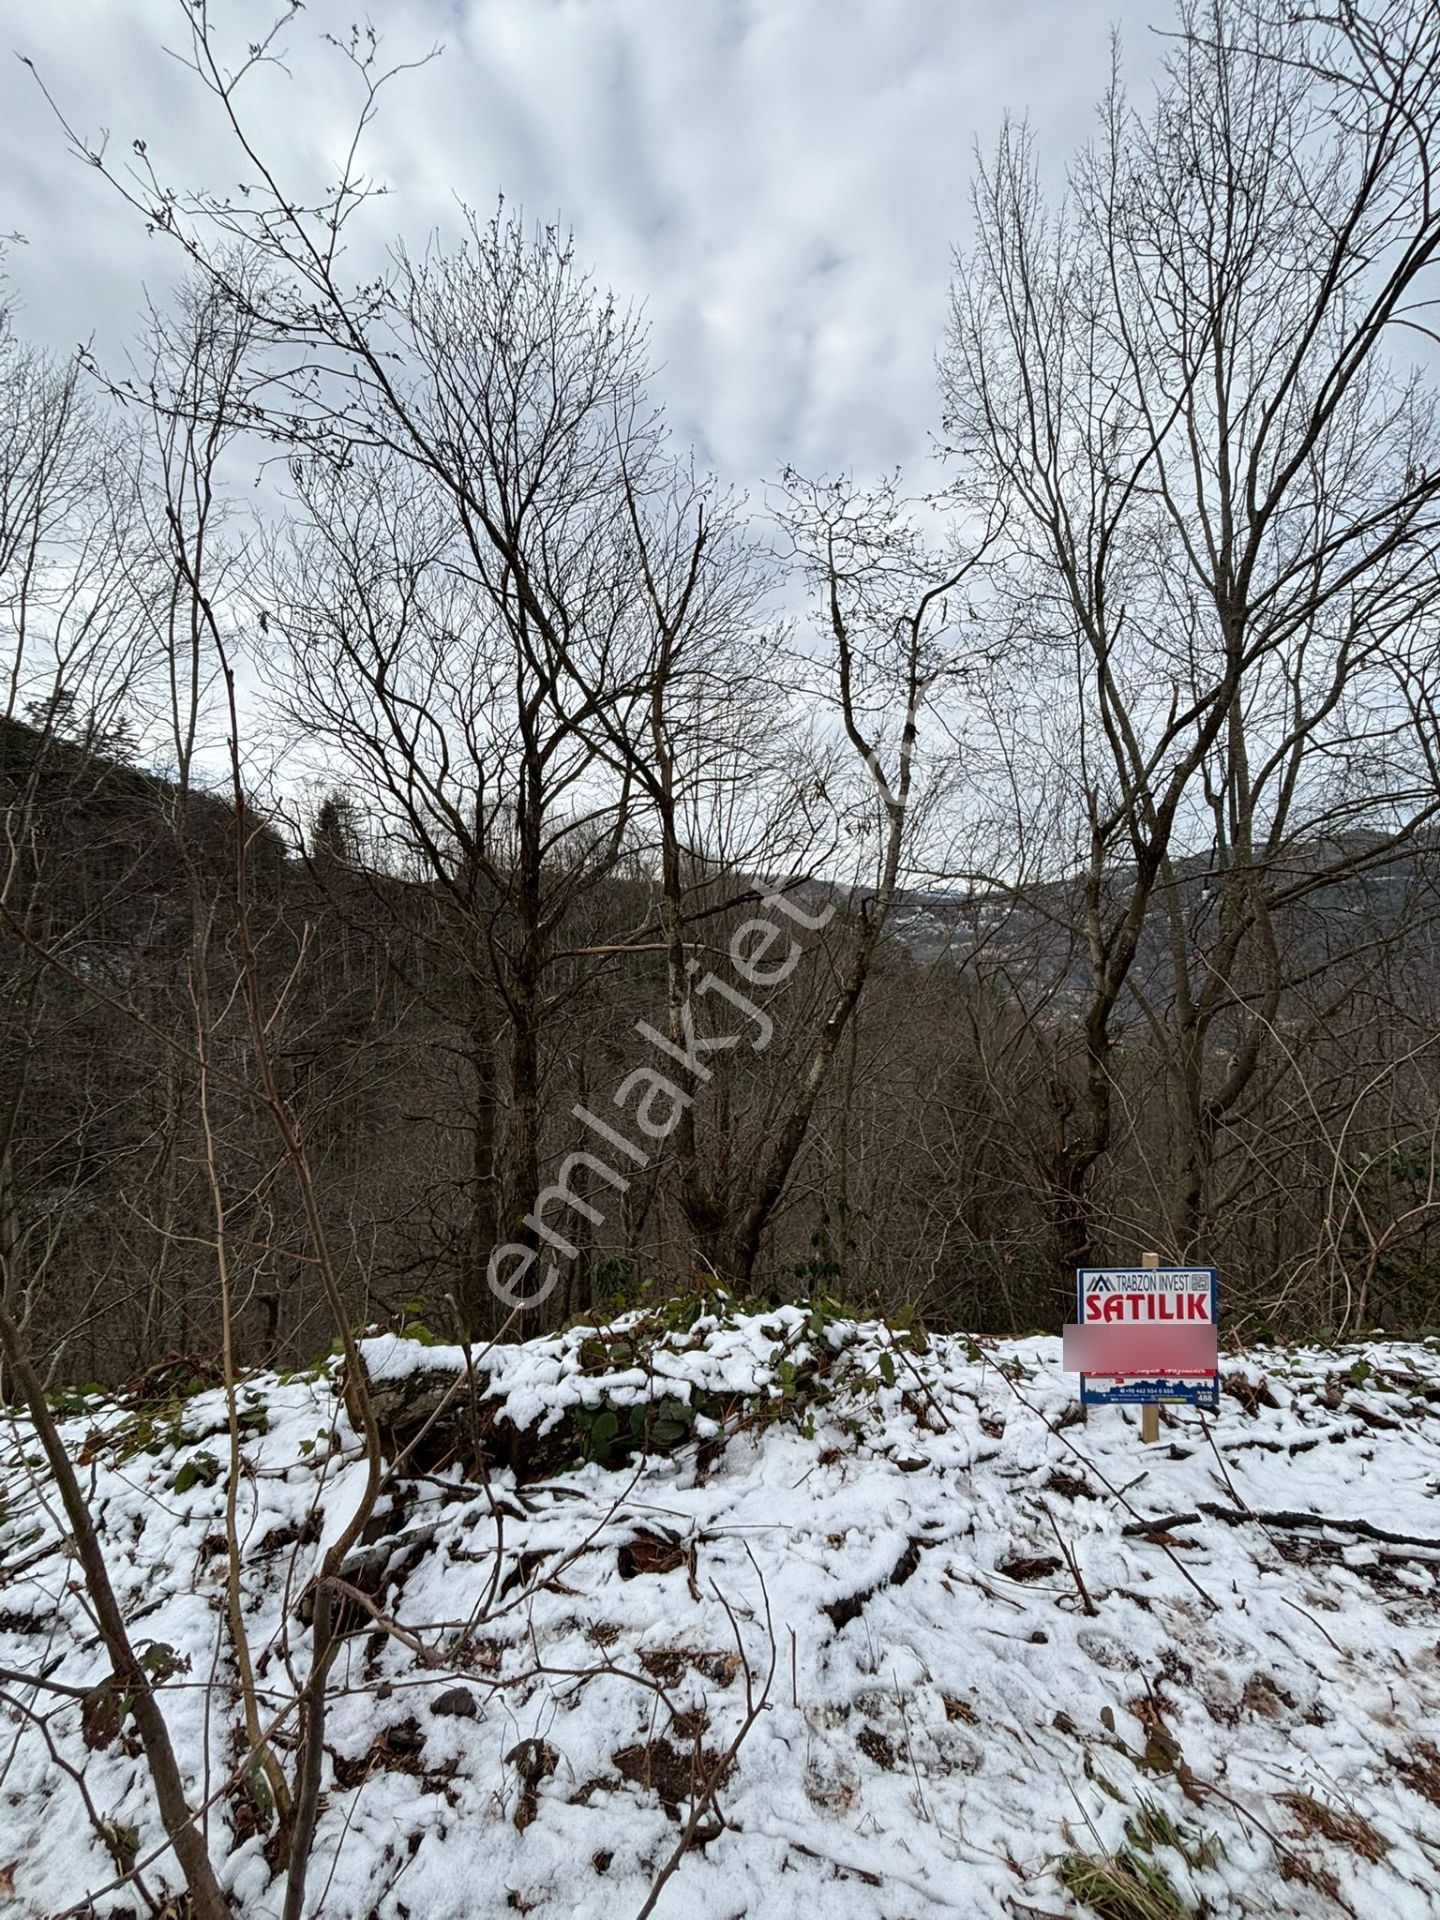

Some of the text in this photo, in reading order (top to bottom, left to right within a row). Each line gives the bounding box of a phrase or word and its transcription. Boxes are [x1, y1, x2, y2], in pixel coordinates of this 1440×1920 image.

[1116, 1274, 1190, 1291] TRABZON INVEST
[1086, 1293, 1209, 1323] SATILIK
